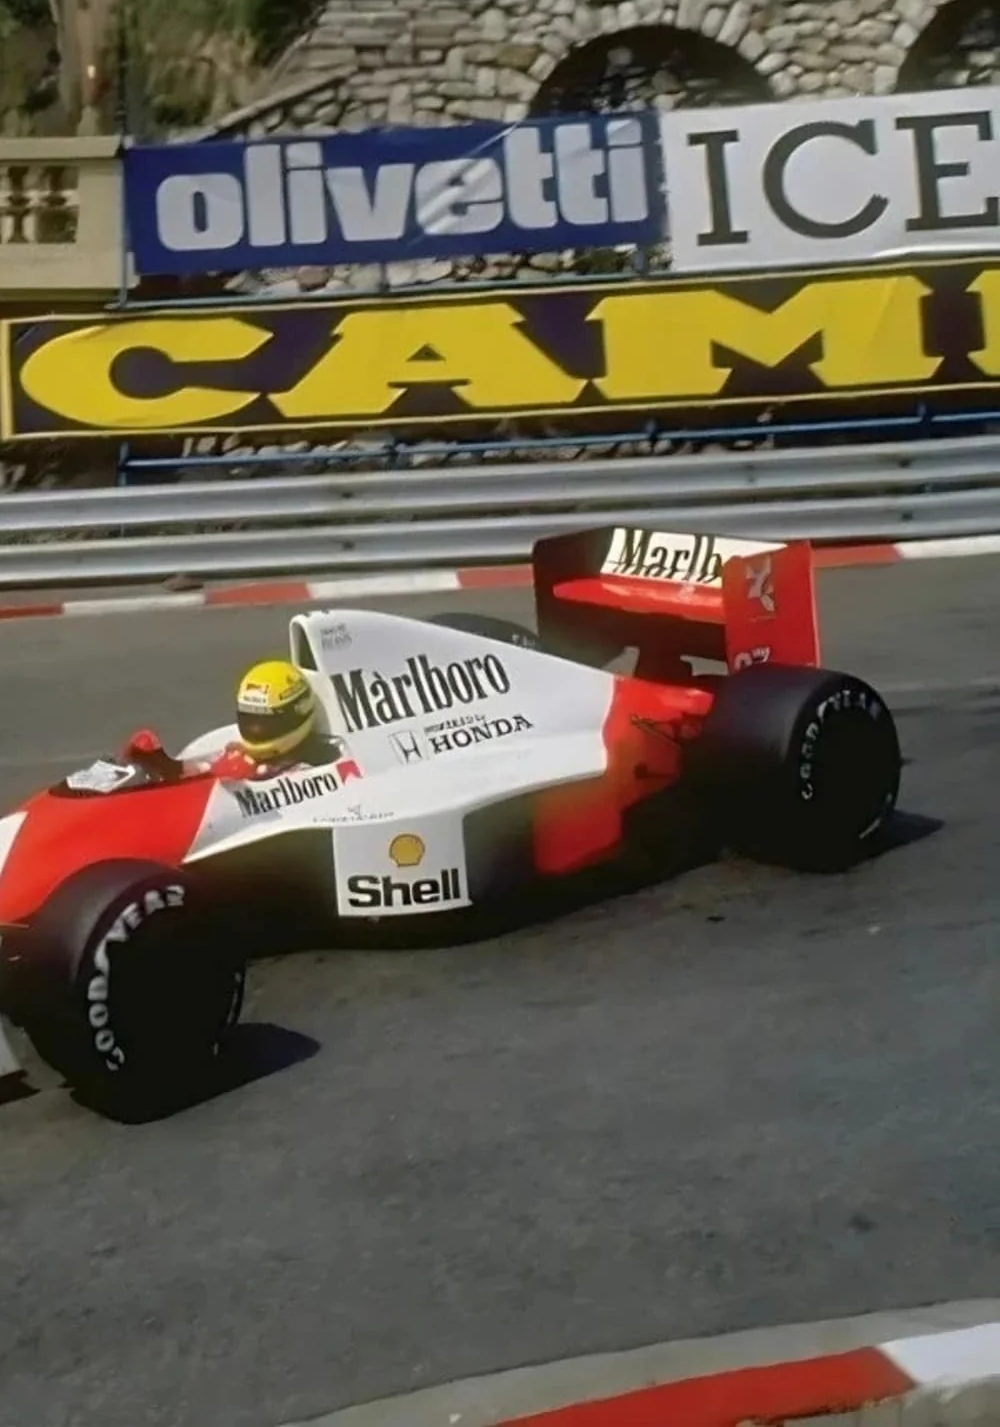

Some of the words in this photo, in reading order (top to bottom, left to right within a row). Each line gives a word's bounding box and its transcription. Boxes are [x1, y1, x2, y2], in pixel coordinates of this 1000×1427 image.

[155, 119, 649, 253] olivetti
[686, 109, 1000, 246] ICE
[607, 528, 722, 584] Marlb
[330, 653, 511, 733] Marlboro
[429, 713, 535, 754] HONDA
[235, 773, 338, 818] Marlboro
[347, 868, 461, 908] Shell
